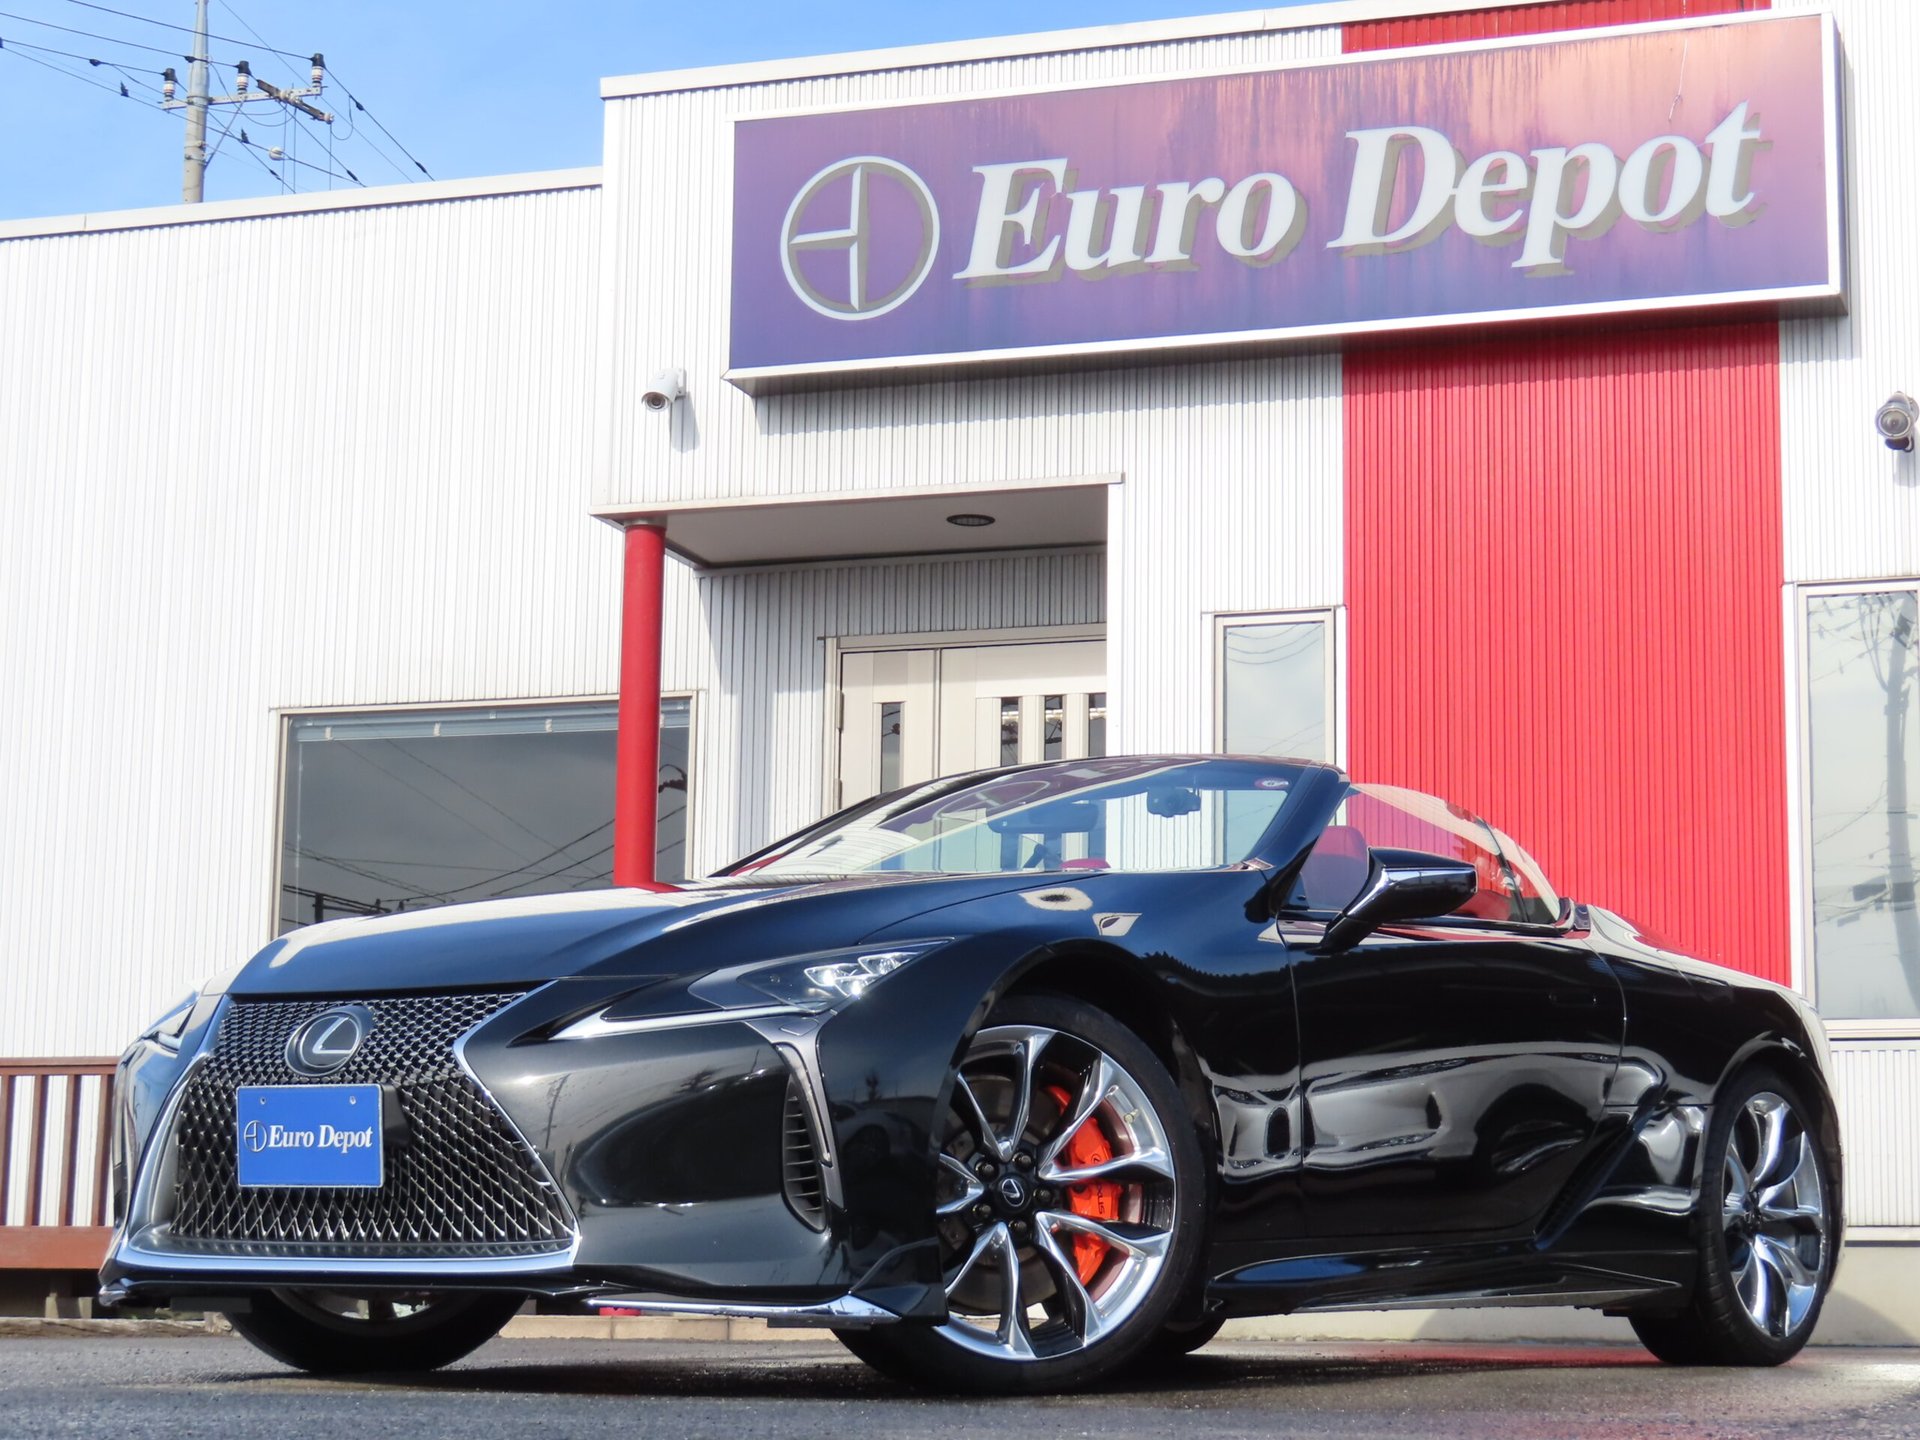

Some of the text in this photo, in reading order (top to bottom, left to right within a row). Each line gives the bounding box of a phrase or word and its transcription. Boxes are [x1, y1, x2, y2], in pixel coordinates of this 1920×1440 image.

[951, 101, 1763, 281] Euro Depot
[268, 1124, 373, 1154] Euro Depot
